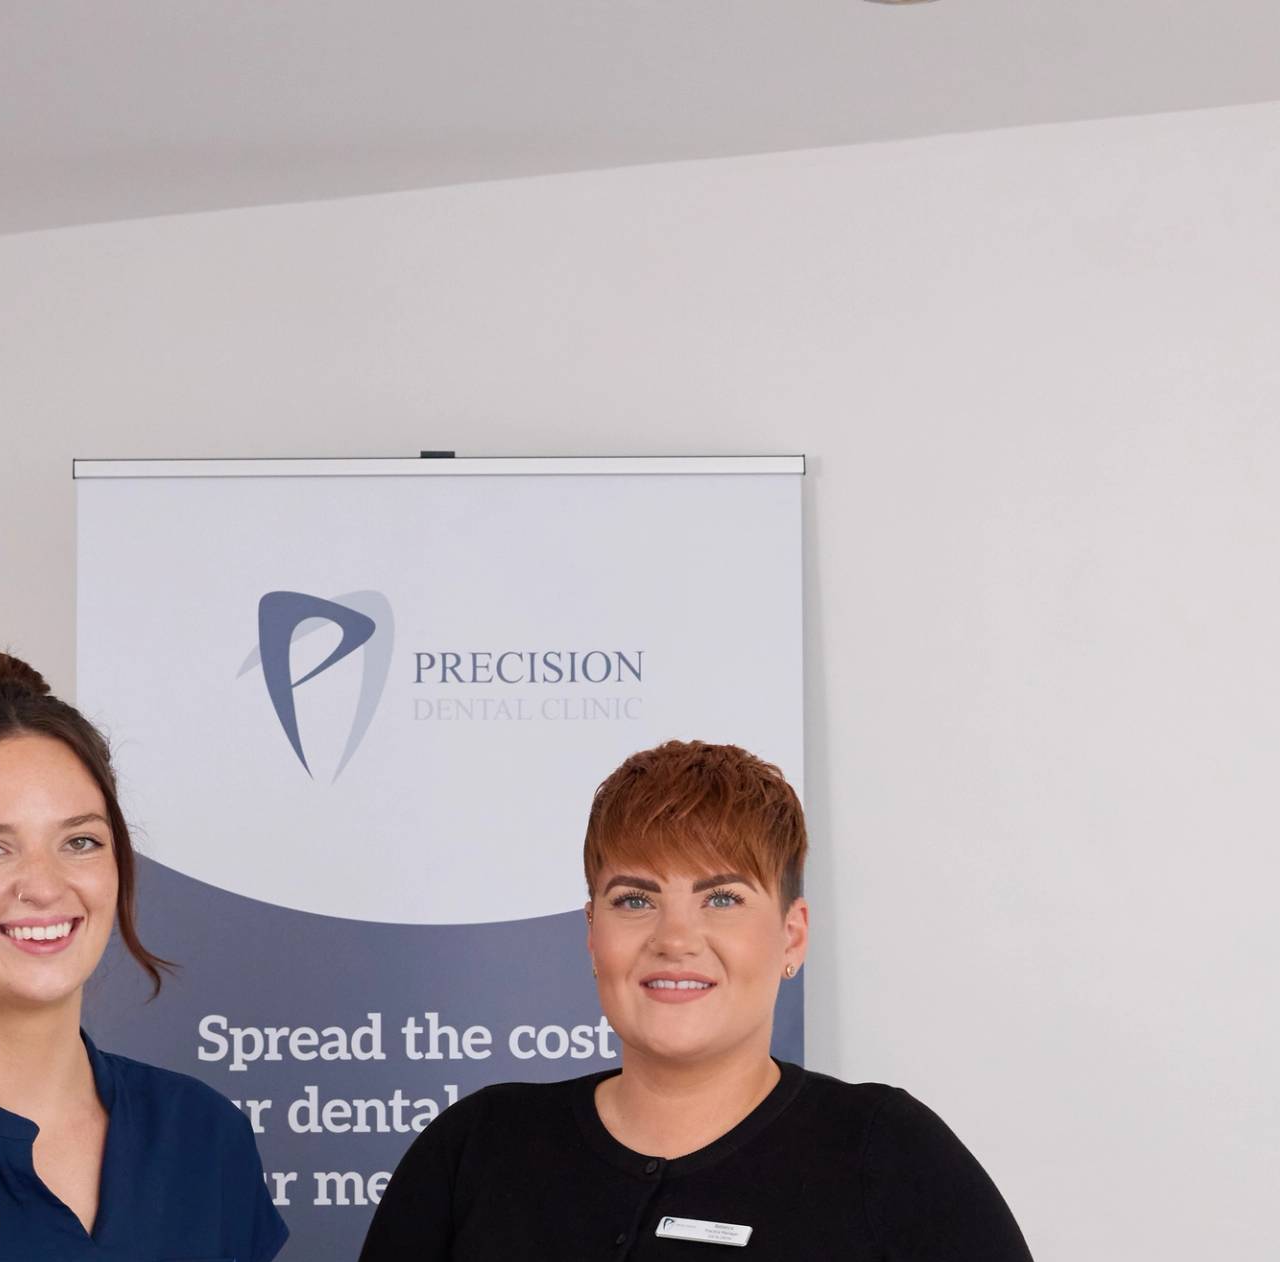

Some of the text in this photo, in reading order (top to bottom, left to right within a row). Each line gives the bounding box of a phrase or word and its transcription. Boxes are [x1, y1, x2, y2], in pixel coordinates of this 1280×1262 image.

[413, 650, 646, 684] PRECISION
[412, 697, 644, 721] DENTAL CLINIC
[197, 1012, 618, 1072] Spread the cost
